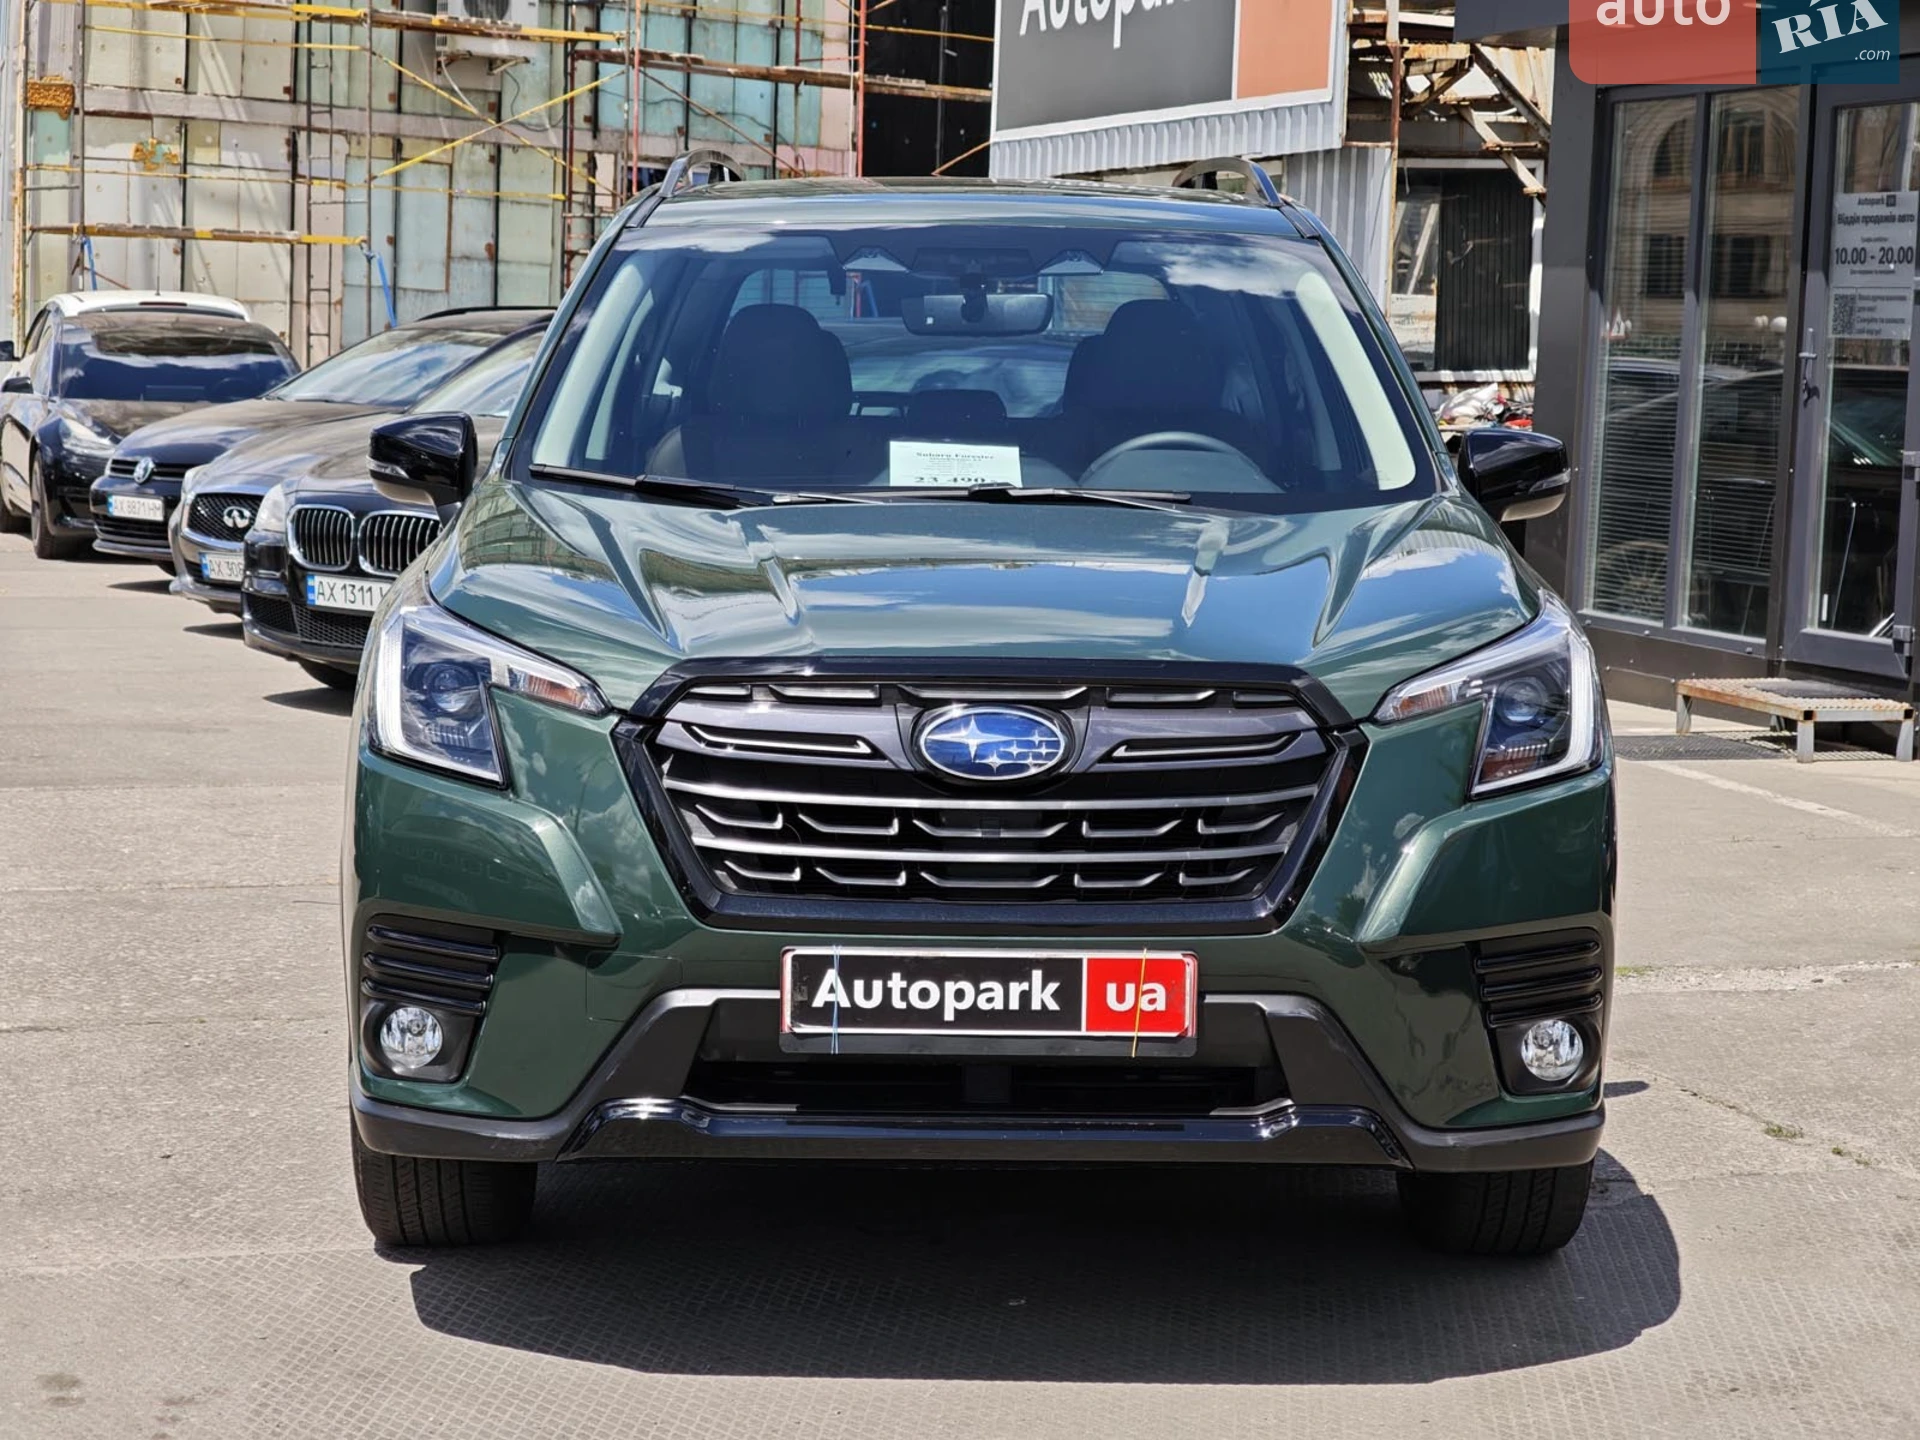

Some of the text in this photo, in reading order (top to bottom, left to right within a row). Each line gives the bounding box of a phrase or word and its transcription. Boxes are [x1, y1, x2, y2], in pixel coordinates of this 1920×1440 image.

[1834, 246, 1867, 265] 10.00
[1878, 245, 1914, 265] 20.00
[209, 559, 224, 577] AX
[317, 580, 337, 602] AX
[340, 583, 373, 606] 1311
[811, 968, 1167, 1022] Autopark ua
